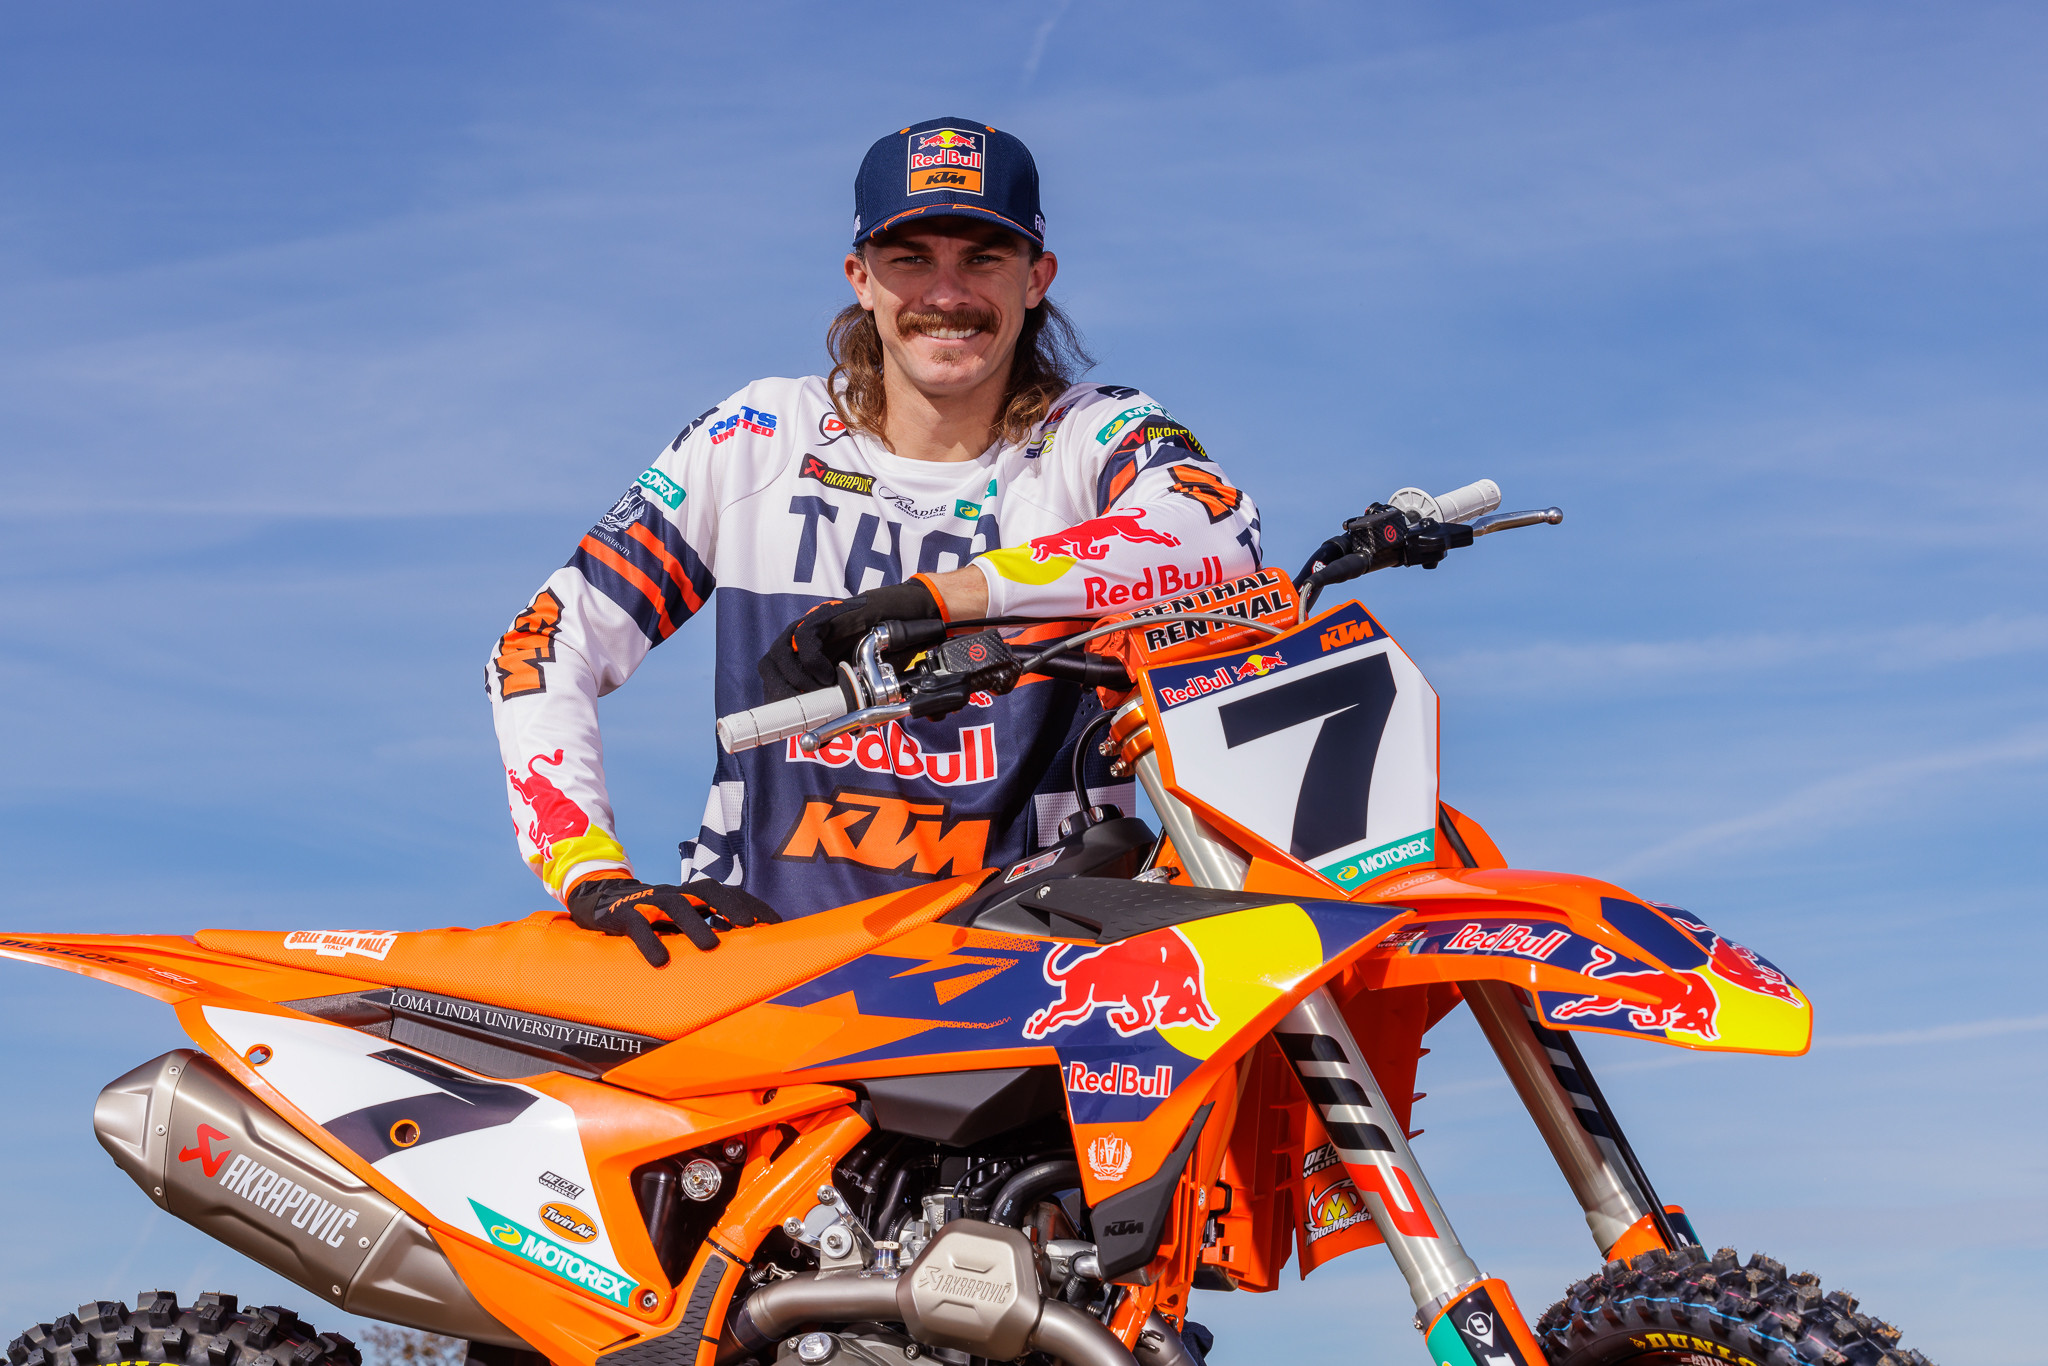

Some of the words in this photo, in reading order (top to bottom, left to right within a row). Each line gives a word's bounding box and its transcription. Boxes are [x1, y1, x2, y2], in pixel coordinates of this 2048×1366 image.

[911, 149, 946, 169] Red
[947, 150, 981, 169] Bull
[925, 172, 967, 185] KTM
[709, 405, 778, 438] PATS
[1083, 567, 1156, 610] Red
[1158, 556, 1224, 597] Bull
[1133, 571, 1278, 619] RENTHAL
[1144, 590, 1293, 653] RENTHAL
[1319, 620, 1374, 652] KTM
[1160, 673, 1199, 707] Red
[1194, 667, 1233, 697] Bull
[889, 721, 998, 786] Bull
[1218, 651, 1398, 863] 7
[776, 788, 993, 877] KTM
[1359, 838, 1431, 874] MOTOREX
[608, 888, 654, 914] THOR
[0, 940, 128, 964] DUNLOP
[1444, 923, 1501, 952] Red
[1498, 924, 1571, 960] Bull
[390, 992, 432, 1013] LOMA
[435, 1001, 482, 1023] LINDA
[484, 1011, 574, 1042] UNIVERSITY
[576, 1029, 642, 1054] HEALTH
[1068, 1061, 1120, 1096] Red
[1120, 1062, 1173, 1098] Bull
[219, 1154, 360, 1248] AKRAPOVIČ
[541, 1172, 583, 1195] DECAL
[542, 1206, 577, 1231] Twin
[571, 1223, 597, 1239] Air
[1103, 1220, 1144, 1237] KTM
[520, 1234, 626, 1302] MOTOREX
